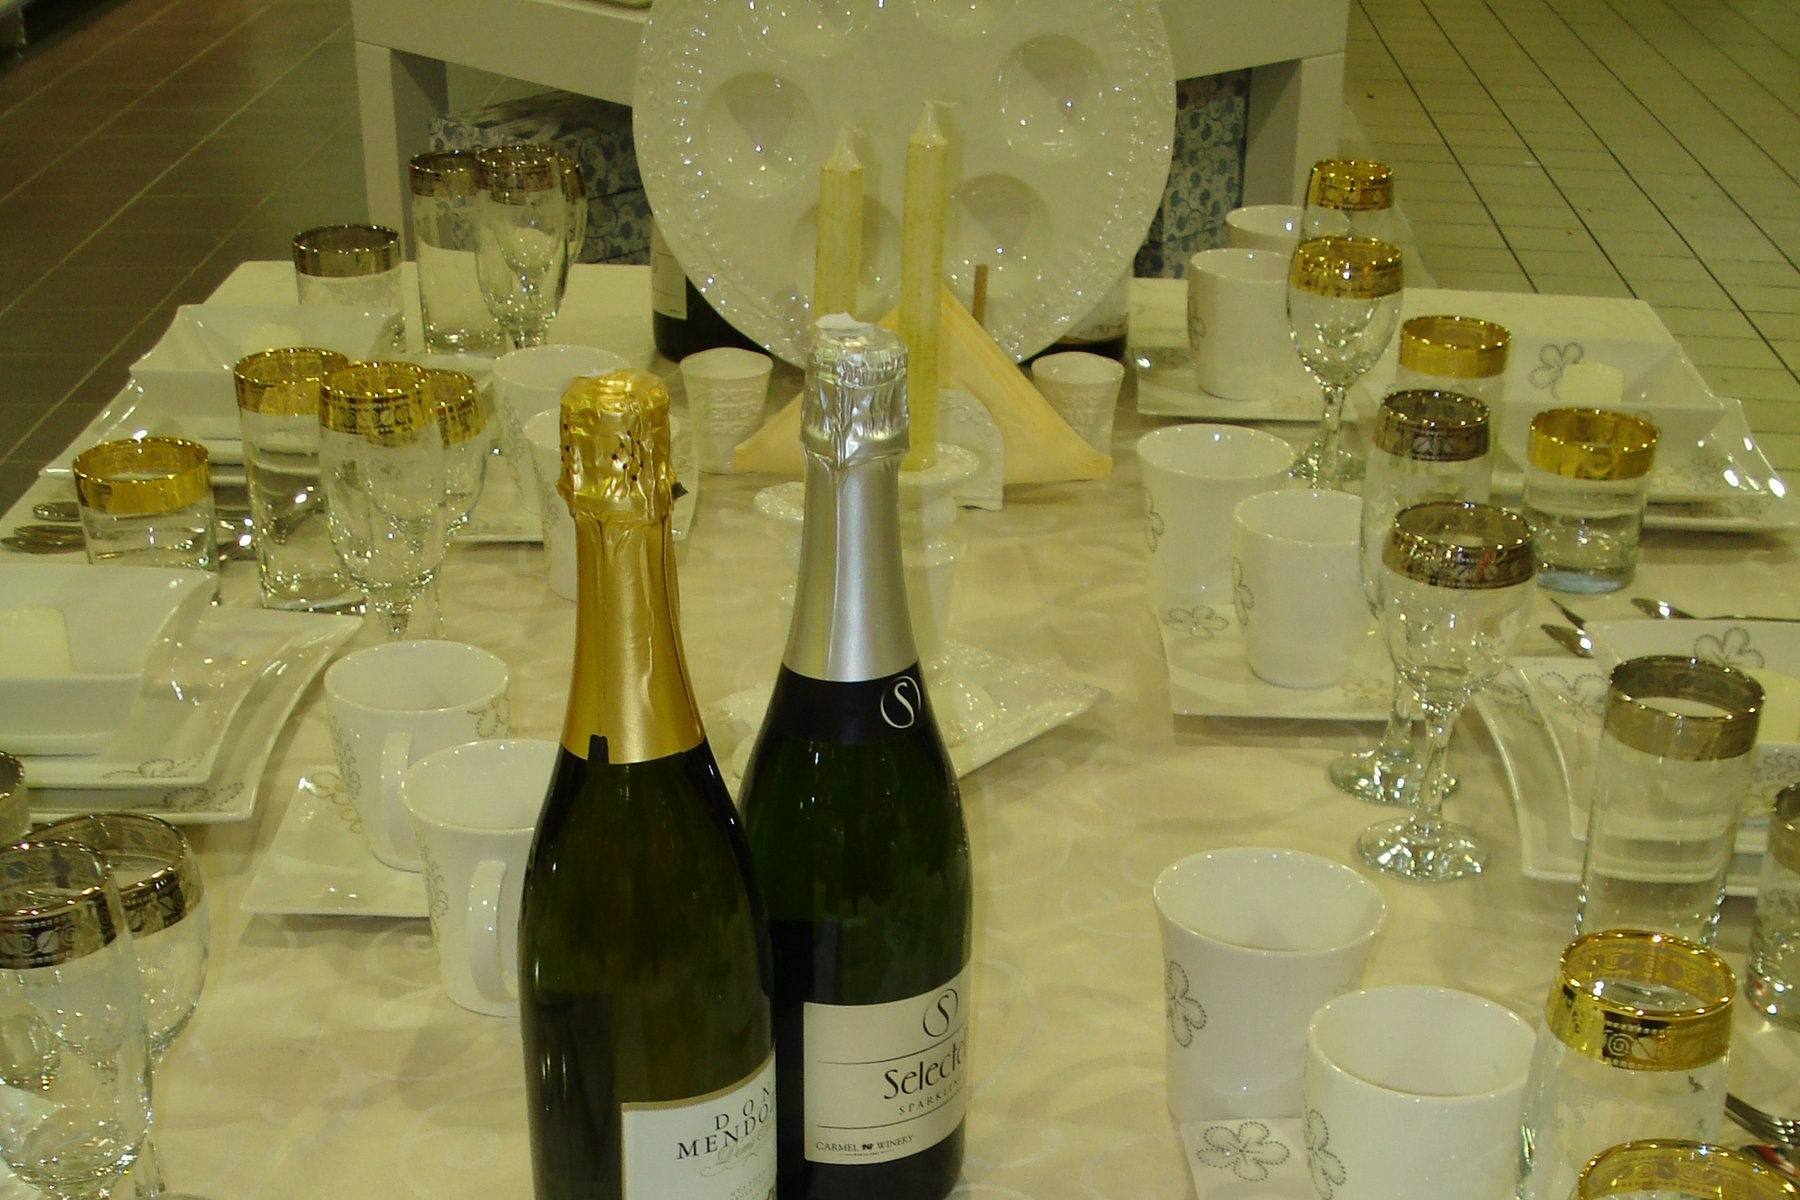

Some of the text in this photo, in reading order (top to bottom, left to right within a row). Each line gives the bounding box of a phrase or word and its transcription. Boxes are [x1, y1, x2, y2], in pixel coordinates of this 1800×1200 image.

[676, 1091, 774, 1160] MENDO
[816, 1134, 914, 1152] CARMEL WINERY
